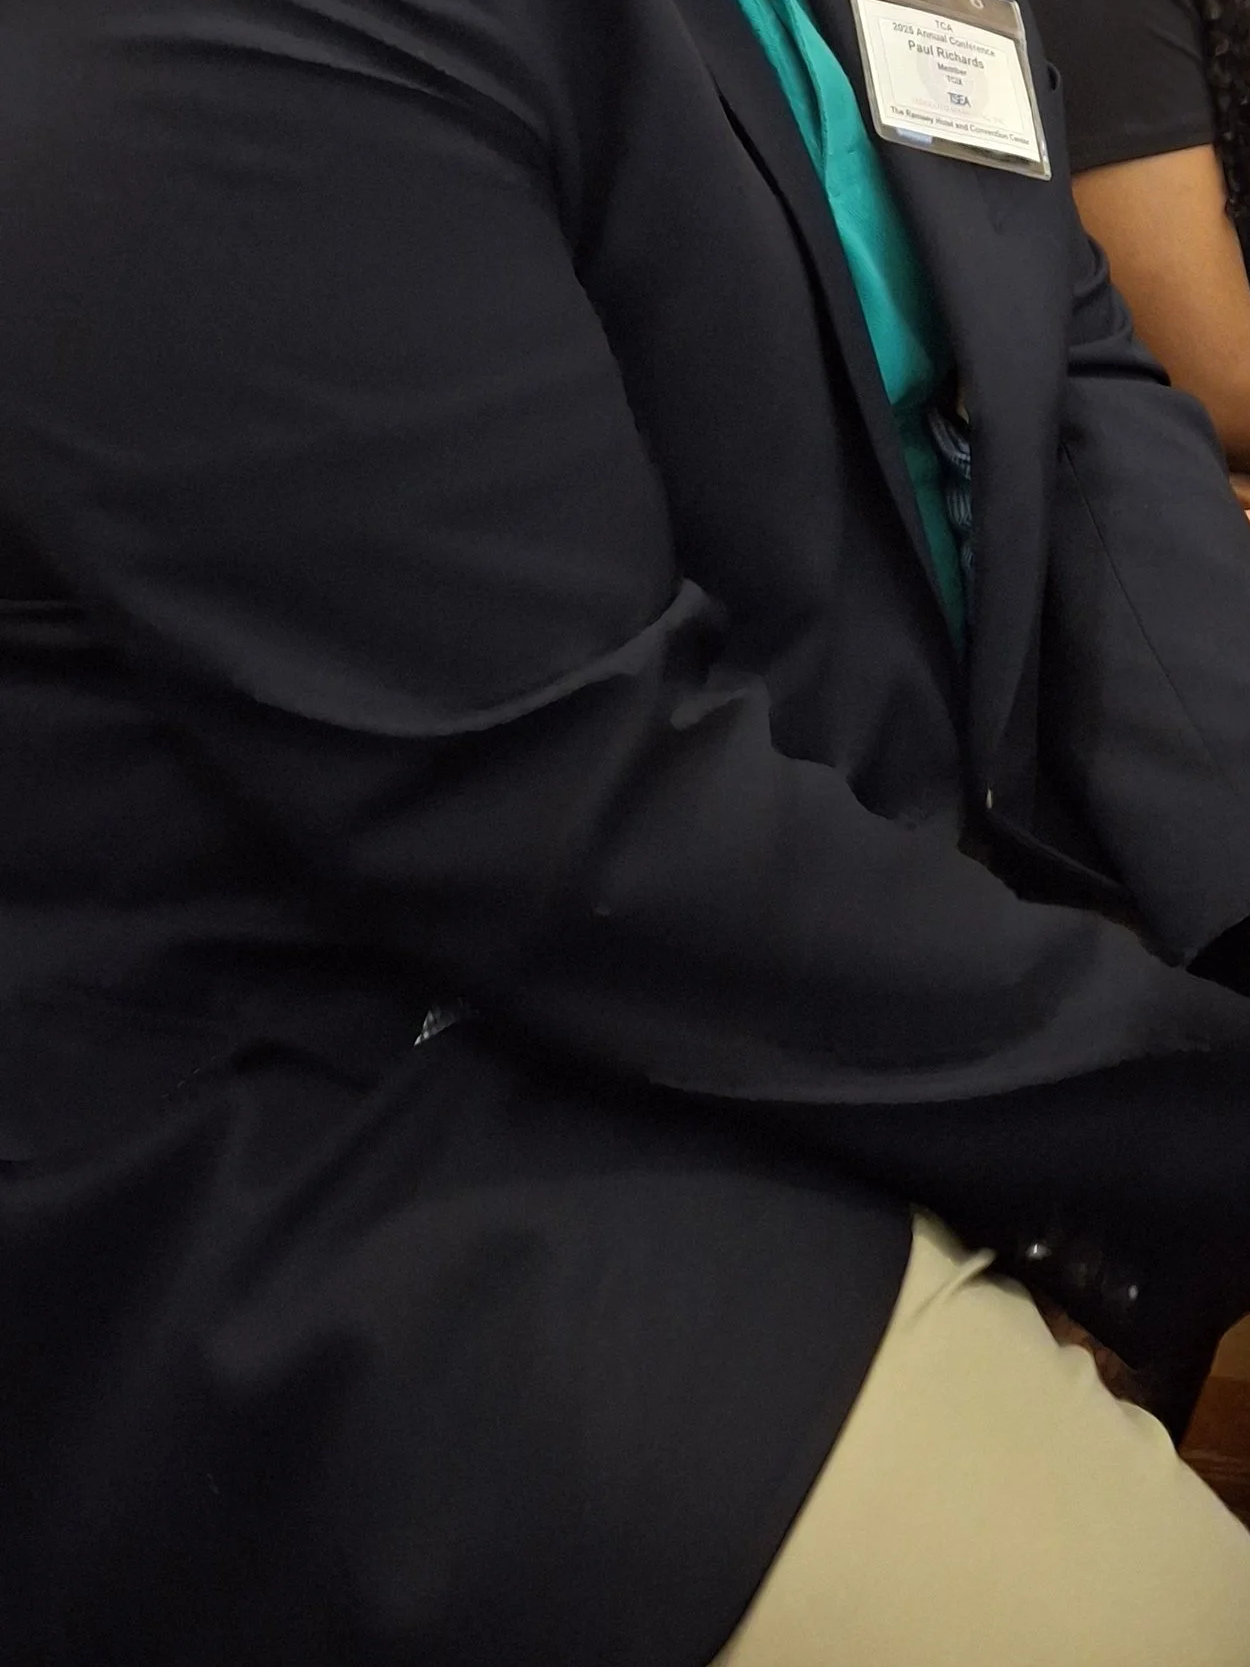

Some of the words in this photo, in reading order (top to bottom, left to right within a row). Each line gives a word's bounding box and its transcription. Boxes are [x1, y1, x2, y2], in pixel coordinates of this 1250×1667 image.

[935, 20, 953, 32] TCA
[908, 39, 934, 56] Paul
[936, 46, 984, 69] Richards
[916, 28, 947, 43] Annual
[949, 36, 995, 56] Conference
[937, 62, 967, 76] Member
[891, 106, 904, 116] The
[955, 121, 969, 131] and
[969, 124, 1008, 139] Convention
[1009, 133, 1030, 145] Center
